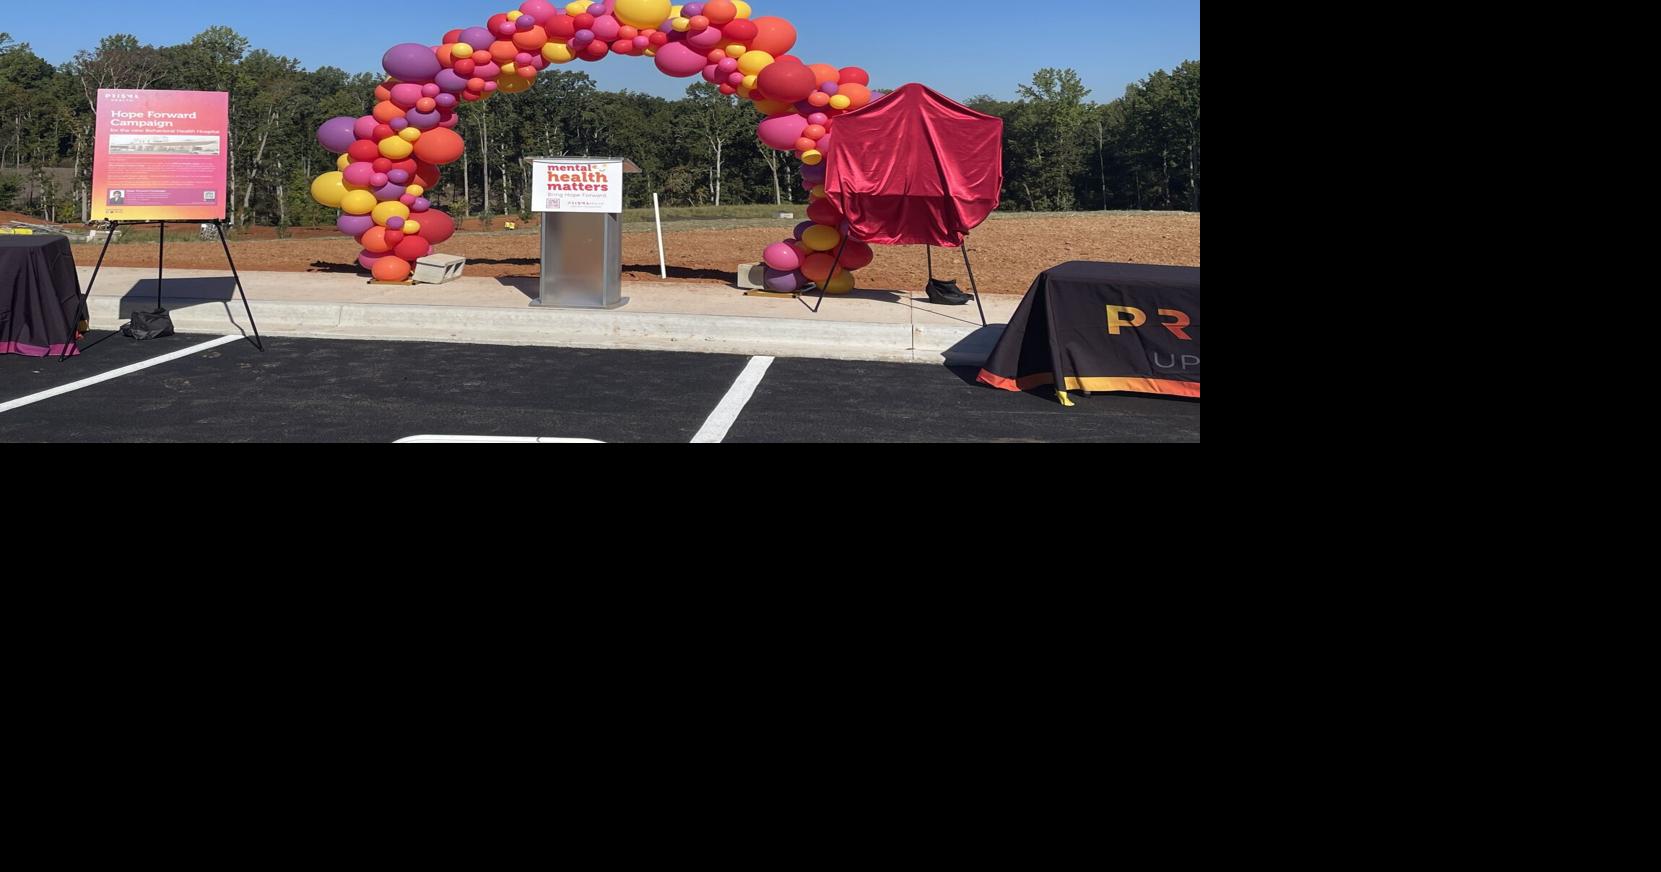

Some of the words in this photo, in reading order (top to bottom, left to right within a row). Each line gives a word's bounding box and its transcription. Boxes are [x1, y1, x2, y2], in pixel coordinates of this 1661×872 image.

[111, 110, 144, 119] Hope
[147, 111, 197, 119] Forward
[110, 119, 174, 128] Campaign
[547, 164, 592, 172] mental
[547, 171, 609, 183] health
[547, 183, 609, 192] matters
